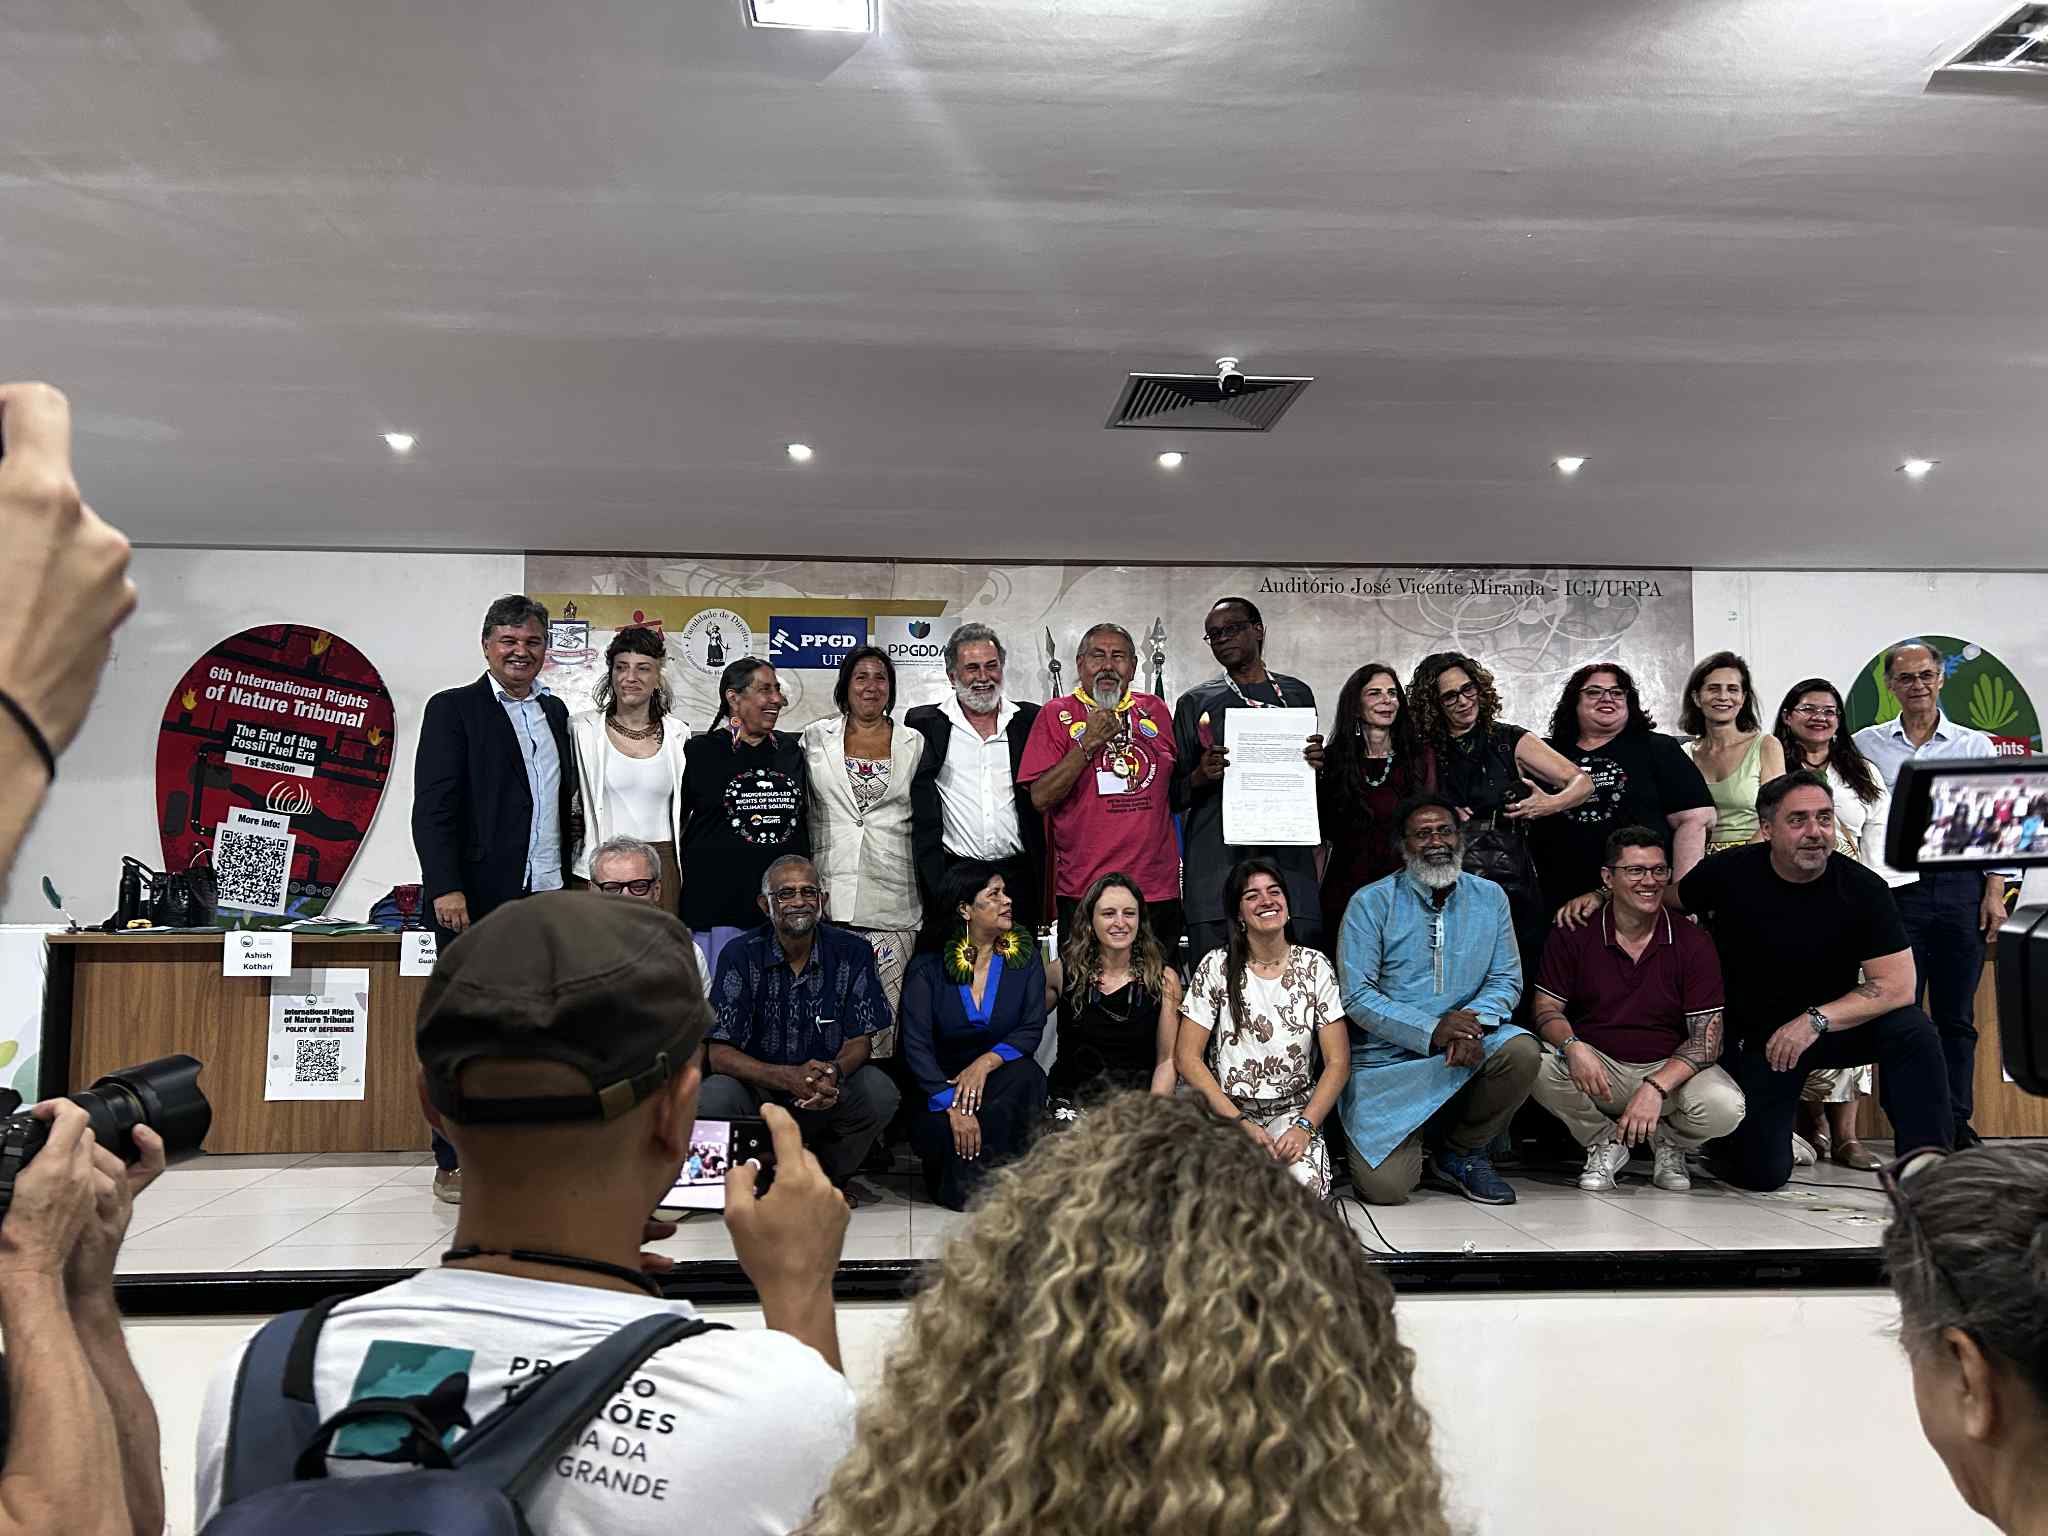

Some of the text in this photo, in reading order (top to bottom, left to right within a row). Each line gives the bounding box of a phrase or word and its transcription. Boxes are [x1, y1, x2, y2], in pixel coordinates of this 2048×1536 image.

[1257, 577, 1345, 595] Auditório
[1350, 577, 1392, 595] José
[1398, 577, 1464, 595] Vicente
[1469, 578, 1546, 596] Miranda
[1564, 578, 1663, 598] ICJ/UFPA
[684, 610, 749, 642] Faculdade de Direito
[800, 634, 857, 648] PPGD
[822, 654, 847, 666] UF
[209, 666, 369, 709] 6th International Rights
[205, 685, 365, 728] of Nature Tribunal
[236, 724, 317, 750] The End of the
[231, 736, 315, 762] Fossil Fuel Era
[1994, 741, 2025, 757] ghts
[243, 756, 295, 773] 1st session
[238, 814, 281, 829] More info:
[243, 963, 273, 971] Kothari
[283, 1016, 355, 1024] of Nature Tribunal
[331, 1008, 355, 1017] Rights
[611, 1436, 647, 1463] DA
[555, 1455, 670, 1501] GRANDE
